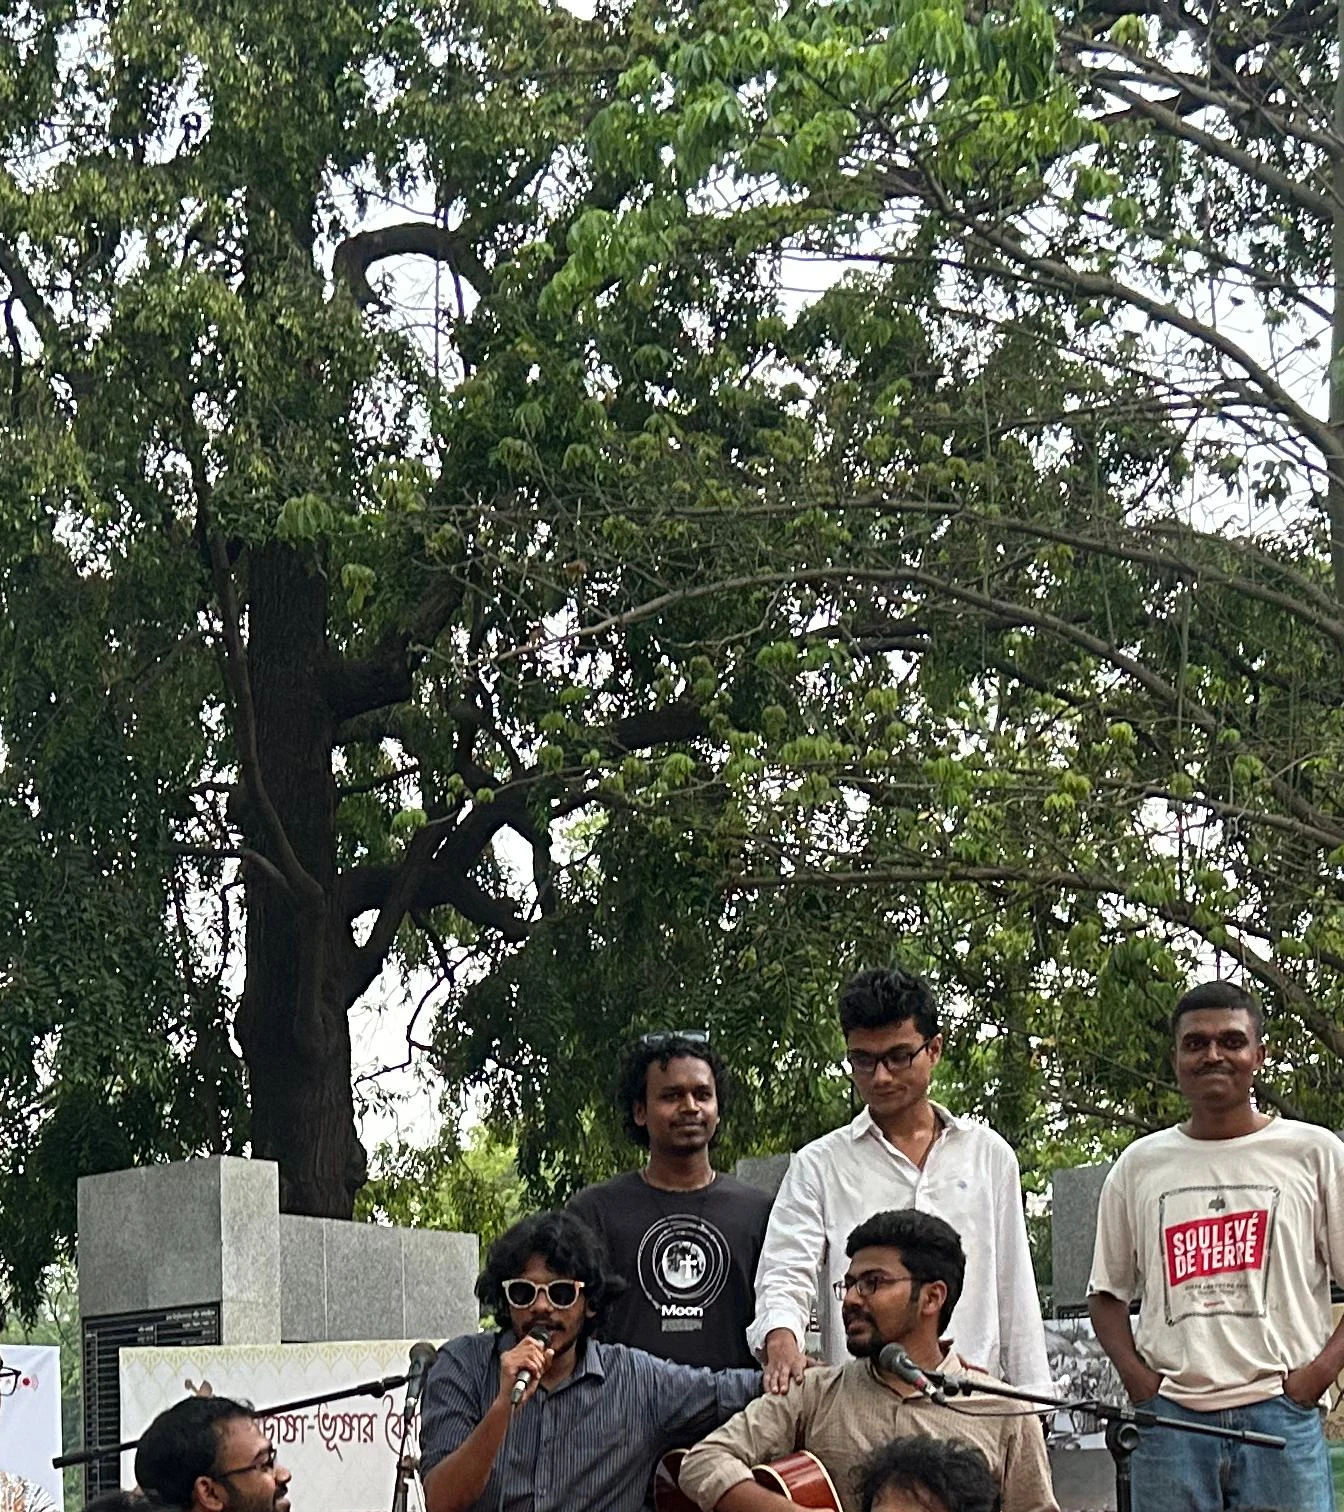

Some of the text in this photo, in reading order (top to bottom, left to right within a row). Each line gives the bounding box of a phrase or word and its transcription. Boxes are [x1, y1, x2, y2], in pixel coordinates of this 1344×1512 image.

[1173, 1213, 1259, 1256] SOULEVÉ
[1175, 1240, 1257, 1278] DE TERRE
[661, 1304, 703, 1317] Moon
